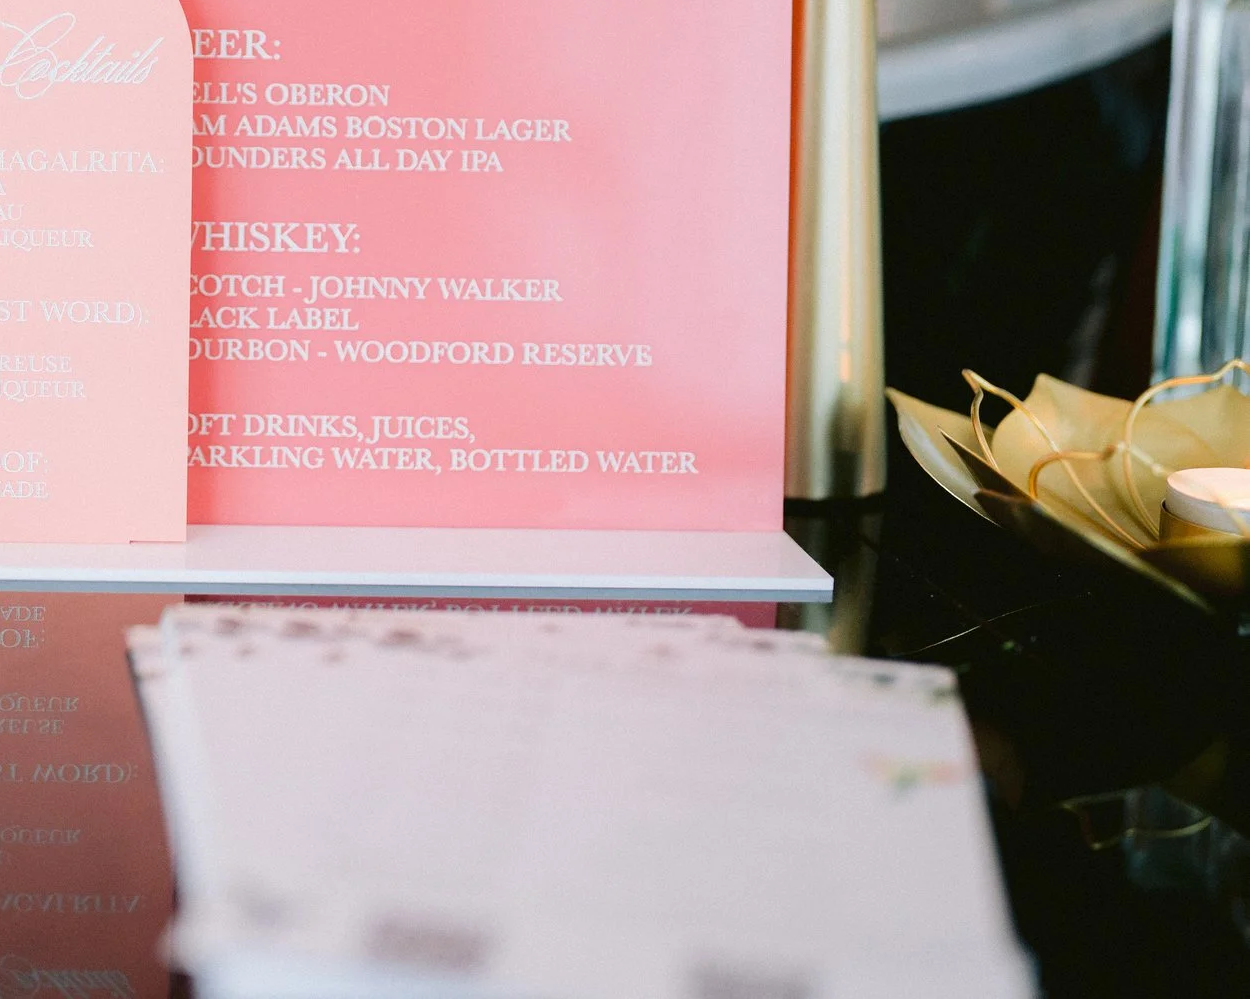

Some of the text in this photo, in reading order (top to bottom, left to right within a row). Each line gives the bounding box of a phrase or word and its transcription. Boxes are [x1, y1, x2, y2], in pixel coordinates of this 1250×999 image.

[193, 26, 282, 61] EER:
[265, 83, 390, 106] OBERON
[234, 115, 337, 138] ADAMS
[345, 115, 468, 140] BOSTON
[475, 118, 572, 142] LAGER
[333, 148, 390, 171] ALL
[396, 149, 453, 172] DAY
[460, 150, 504, 172] IPA
[191, 220, 362, 254] HISKEY:
[303, 276, 432, 304] JOHNNY
[437, 277, 563, 302] WALKER
[40, 300, 150, 327] WORD):
[267, 307, 359, 330] LABEL
[334, 340, 514, 364] WOODFORD
[521, 343, 652, 366] RESERVE
[243, 414, 363, 442] DRINKS,
[366, 416, 475, 444] JUICES,
[331, 447, 441, 475] WATER,
[450, 449, 589, 472] BOTTLED
[596, 451, 698, 474] WATER
